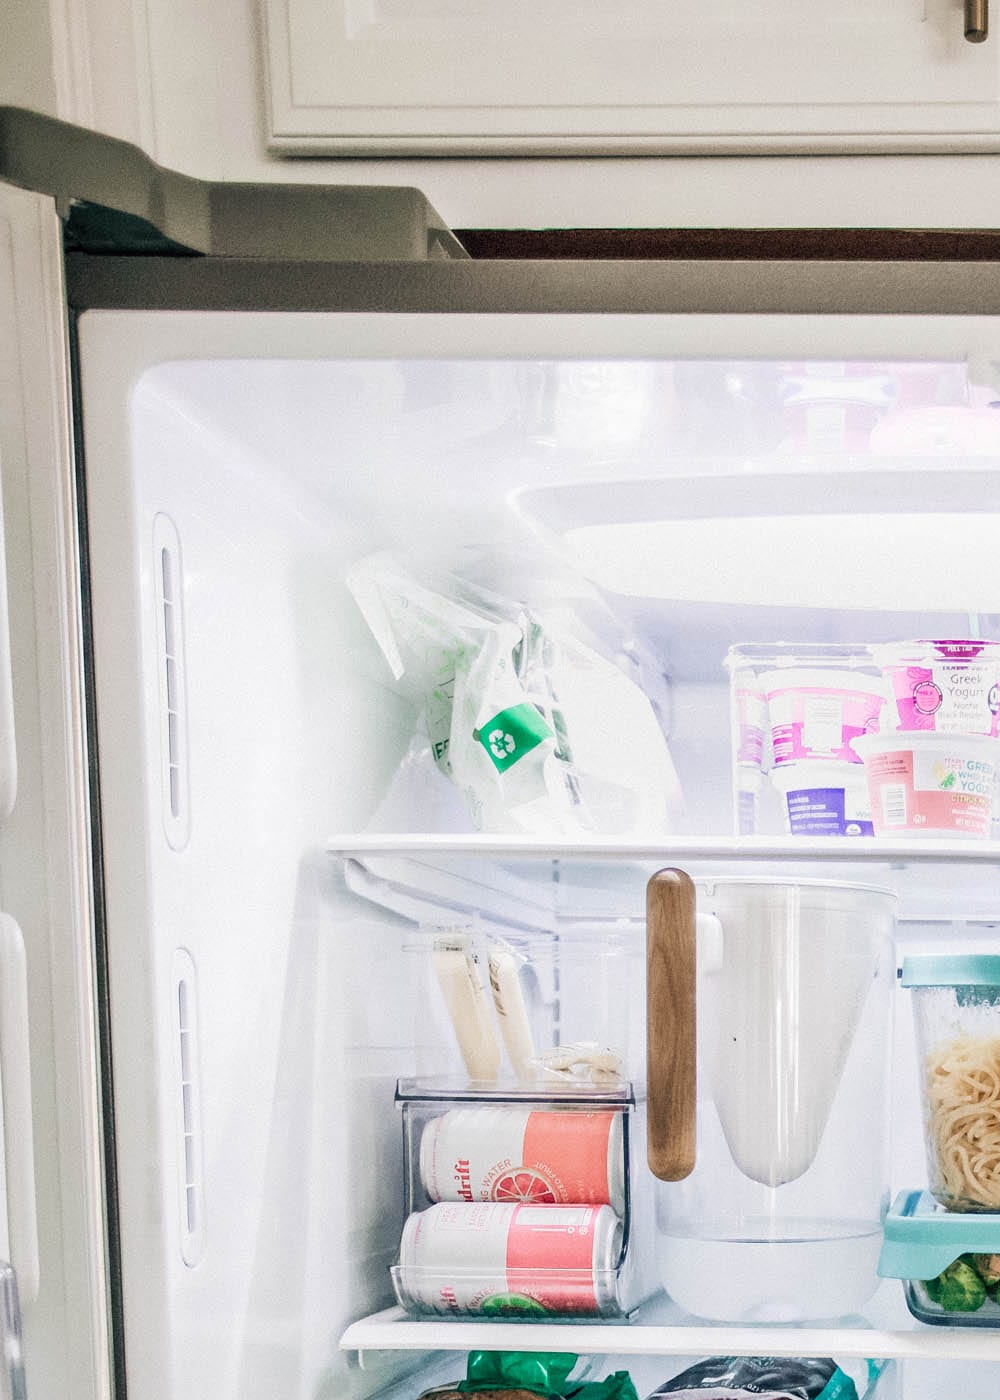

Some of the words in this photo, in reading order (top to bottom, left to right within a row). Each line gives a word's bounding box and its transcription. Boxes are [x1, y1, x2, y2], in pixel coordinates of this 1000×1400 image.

[950, 673, 982, 684] Greek
[947, 687, 984, 699] Yogurt
[484, 1159, 512, 1187] WATER
